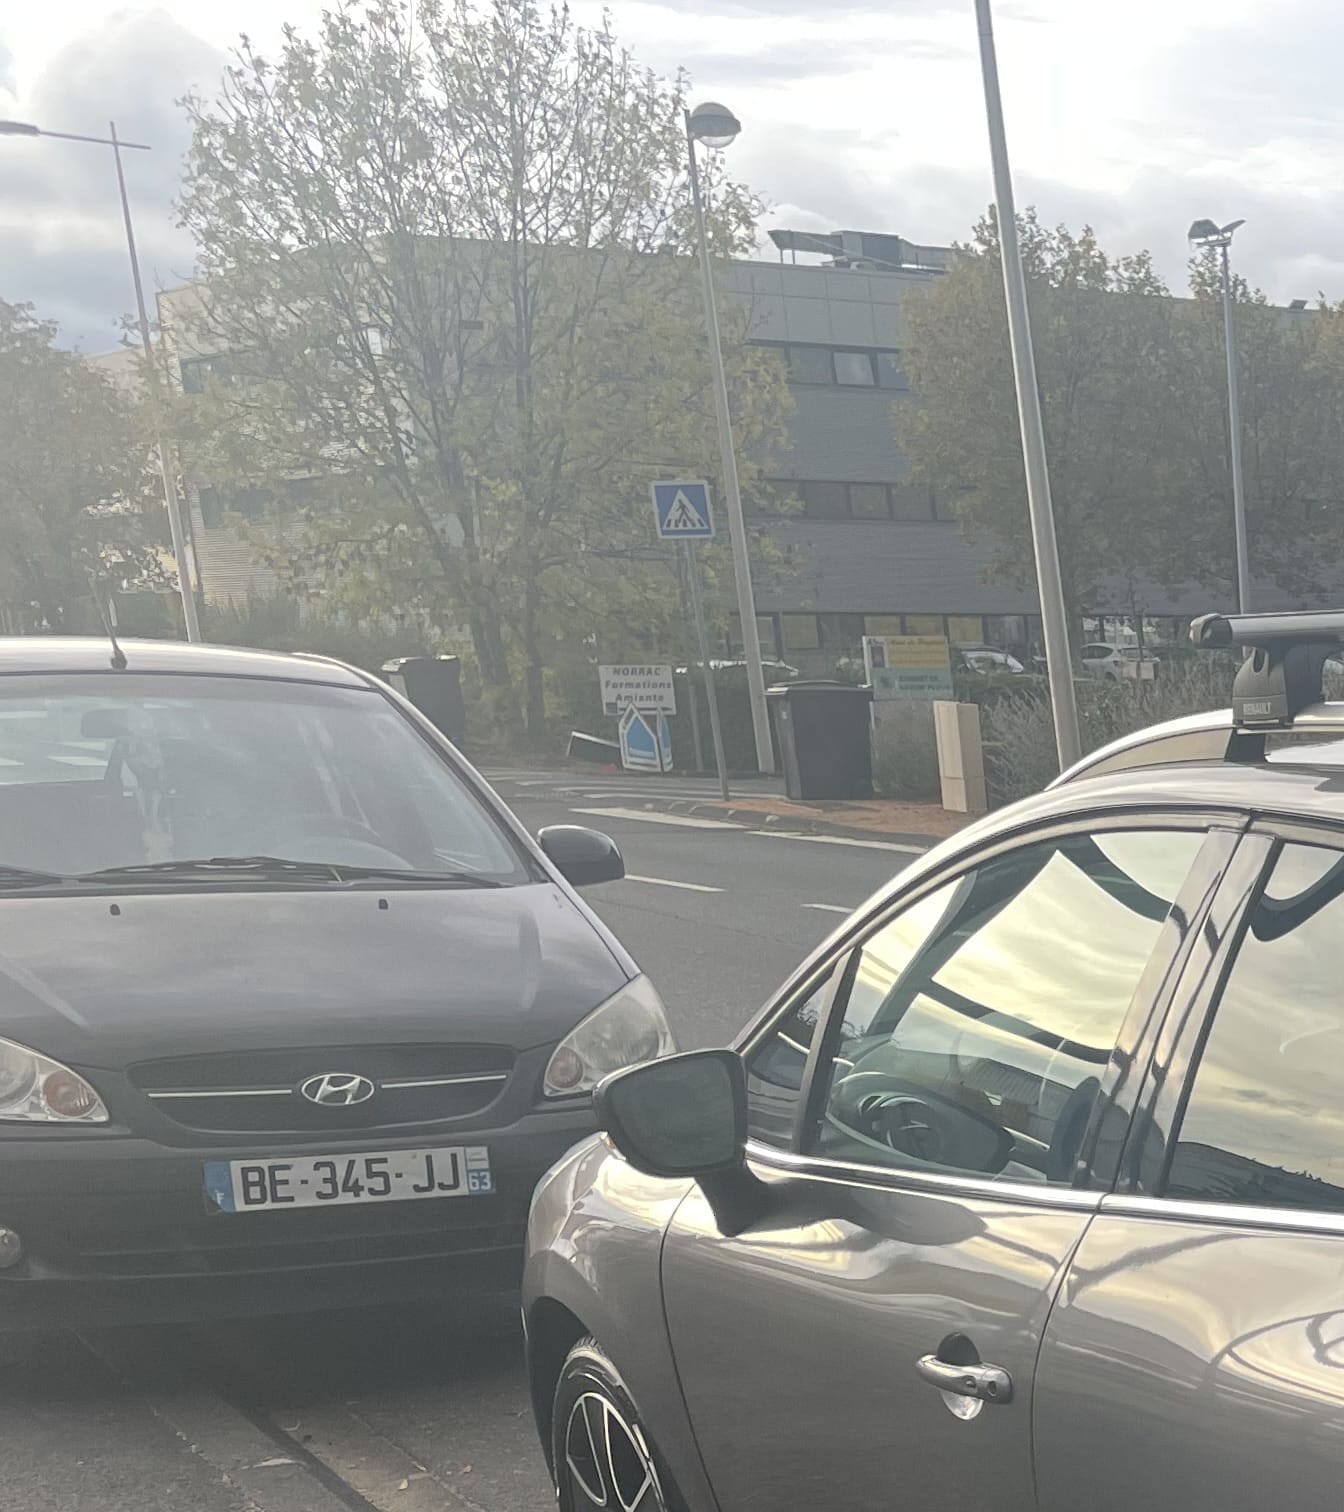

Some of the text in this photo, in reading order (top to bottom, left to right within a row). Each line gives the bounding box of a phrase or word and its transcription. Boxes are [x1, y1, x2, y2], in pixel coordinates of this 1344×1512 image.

[605, 680, 672, 689] Formations
[240, 1152, 460, 1205] BE-345-JJ
[467, 1171, 491, 1191] 63
